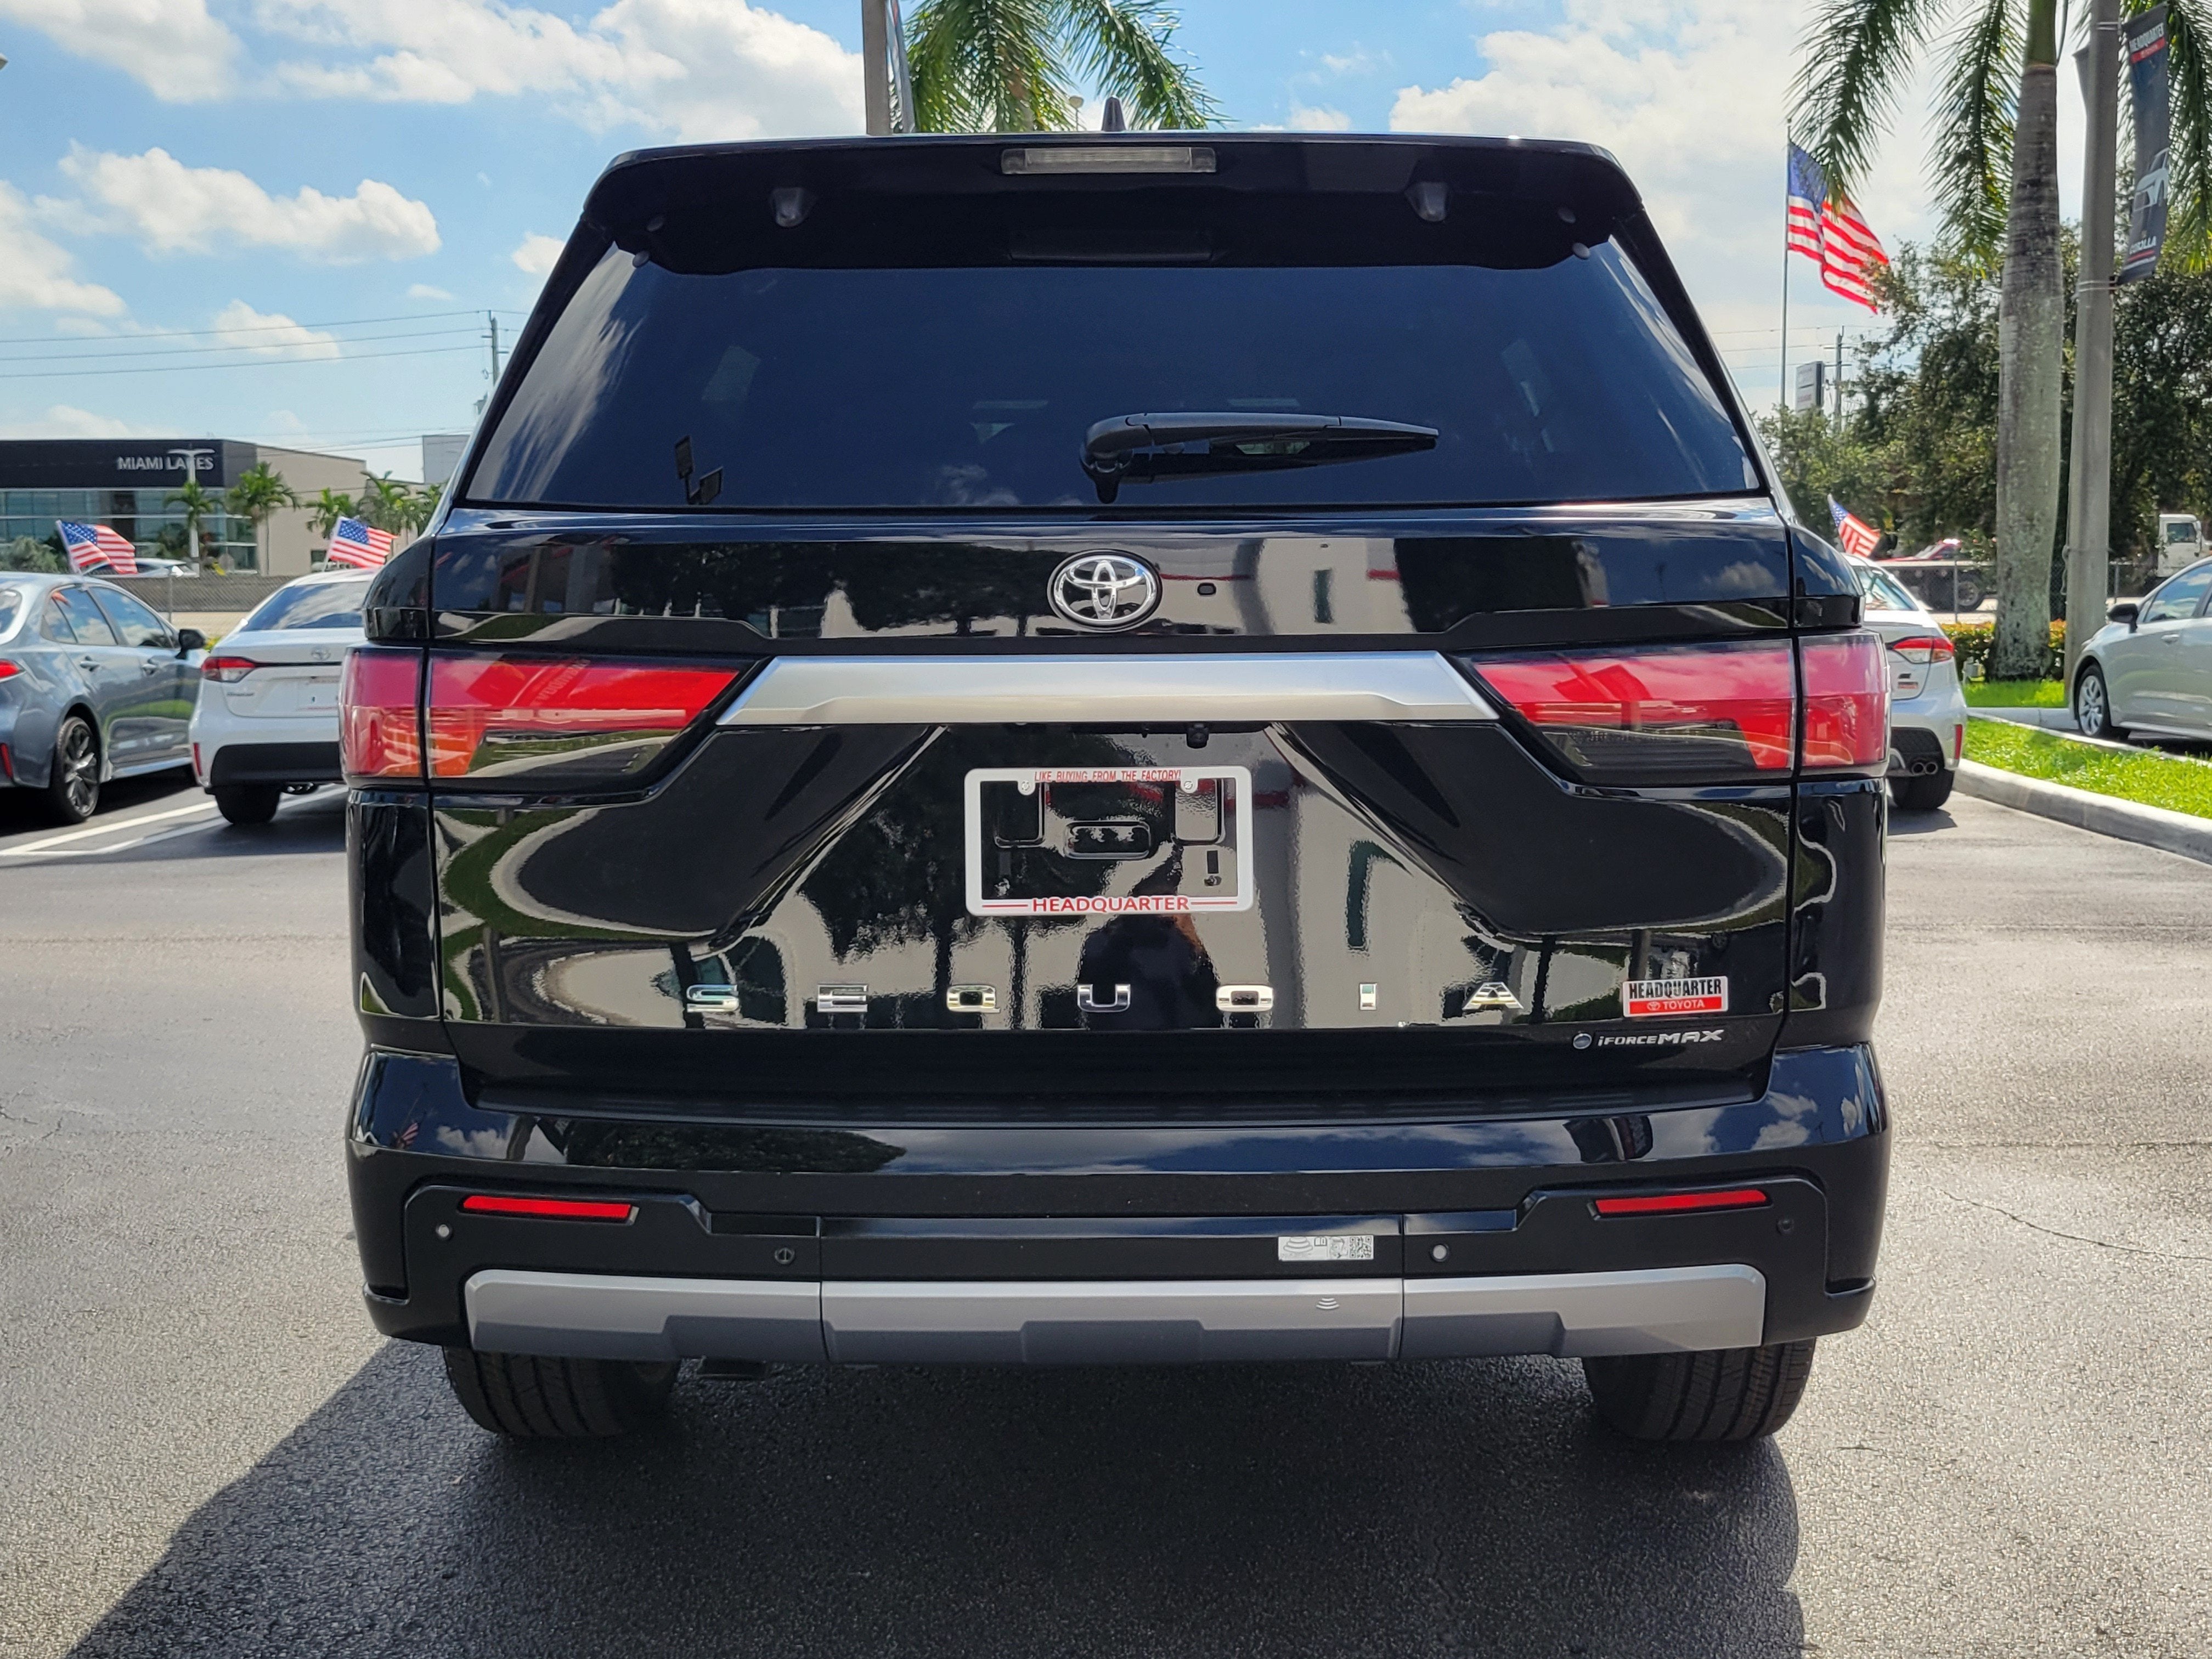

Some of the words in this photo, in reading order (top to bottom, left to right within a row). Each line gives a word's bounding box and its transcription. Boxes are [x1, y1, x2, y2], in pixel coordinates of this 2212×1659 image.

[117, 456, 163, 470] MIAMI
[166, 456, 214, 470] LAES
[1034, 771, 1052, 782] LIKE
[1056, 771, 1087, 782] BUYING
[1092, 770, 1116, 781] FROM
[1121, 770, 1137, 781] THE
[1142, 770, 1181, 781] FACTORY!
[1032, 896, 1189, 912] HEADQUARTER
[1629, 978, 1722, 1000] HEADQUARTER
[686, 982, 1524, 1013] SEQUOIA
[1662, 1000, 1705, 1010] TOYOTA
